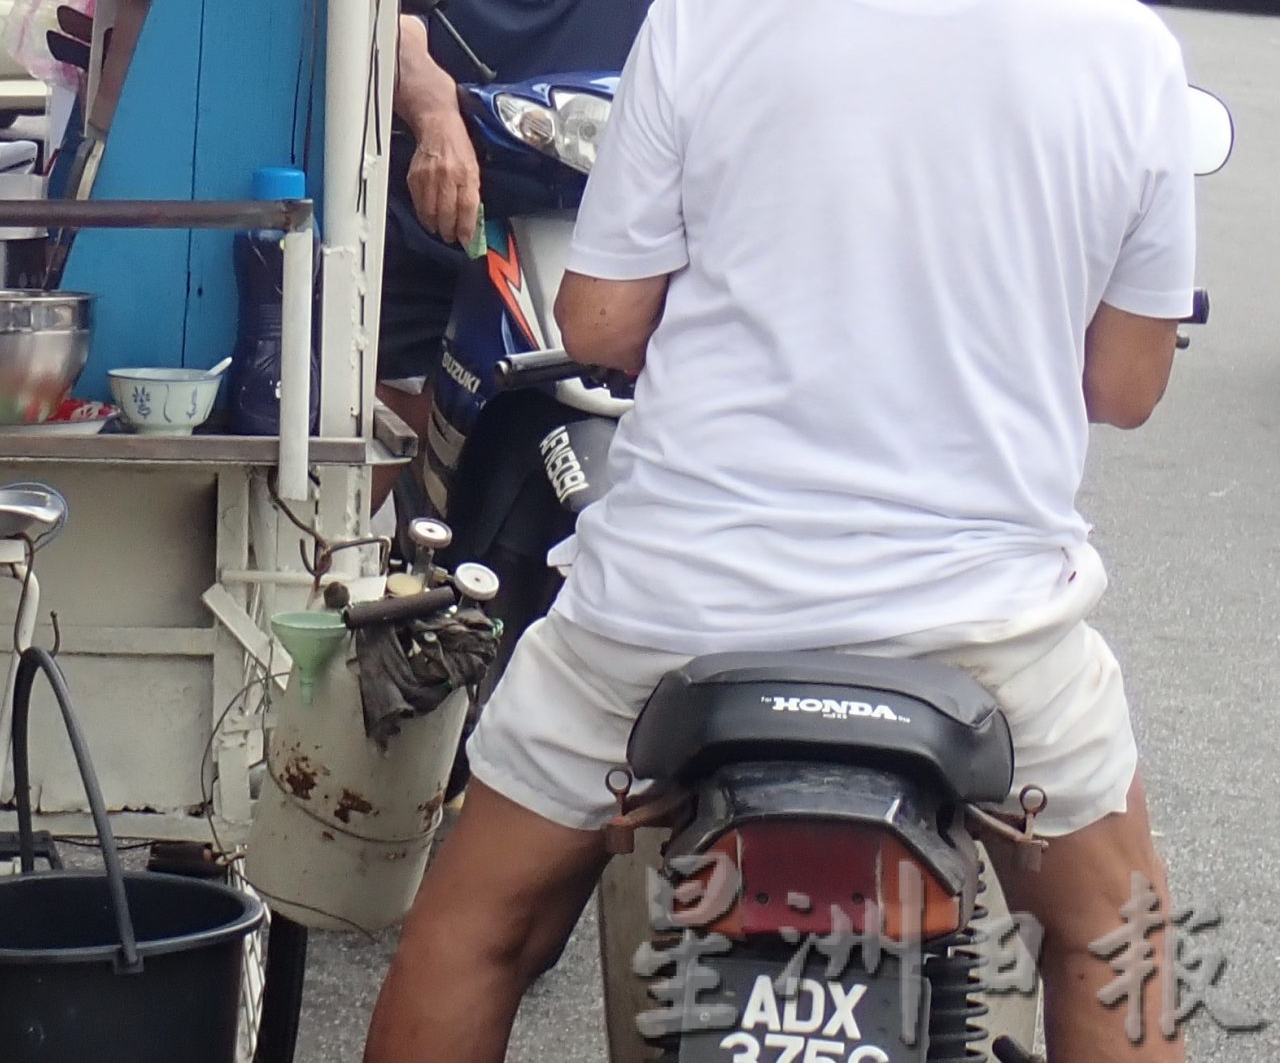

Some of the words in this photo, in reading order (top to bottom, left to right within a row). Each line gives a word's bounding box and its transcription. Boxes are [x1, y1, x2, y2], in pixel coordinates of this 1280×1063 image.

[442, 351, 481, 394] SUZUKI
[772, 697, 898, 721] HONDA
[741, 974, 868, 1040] ADX
